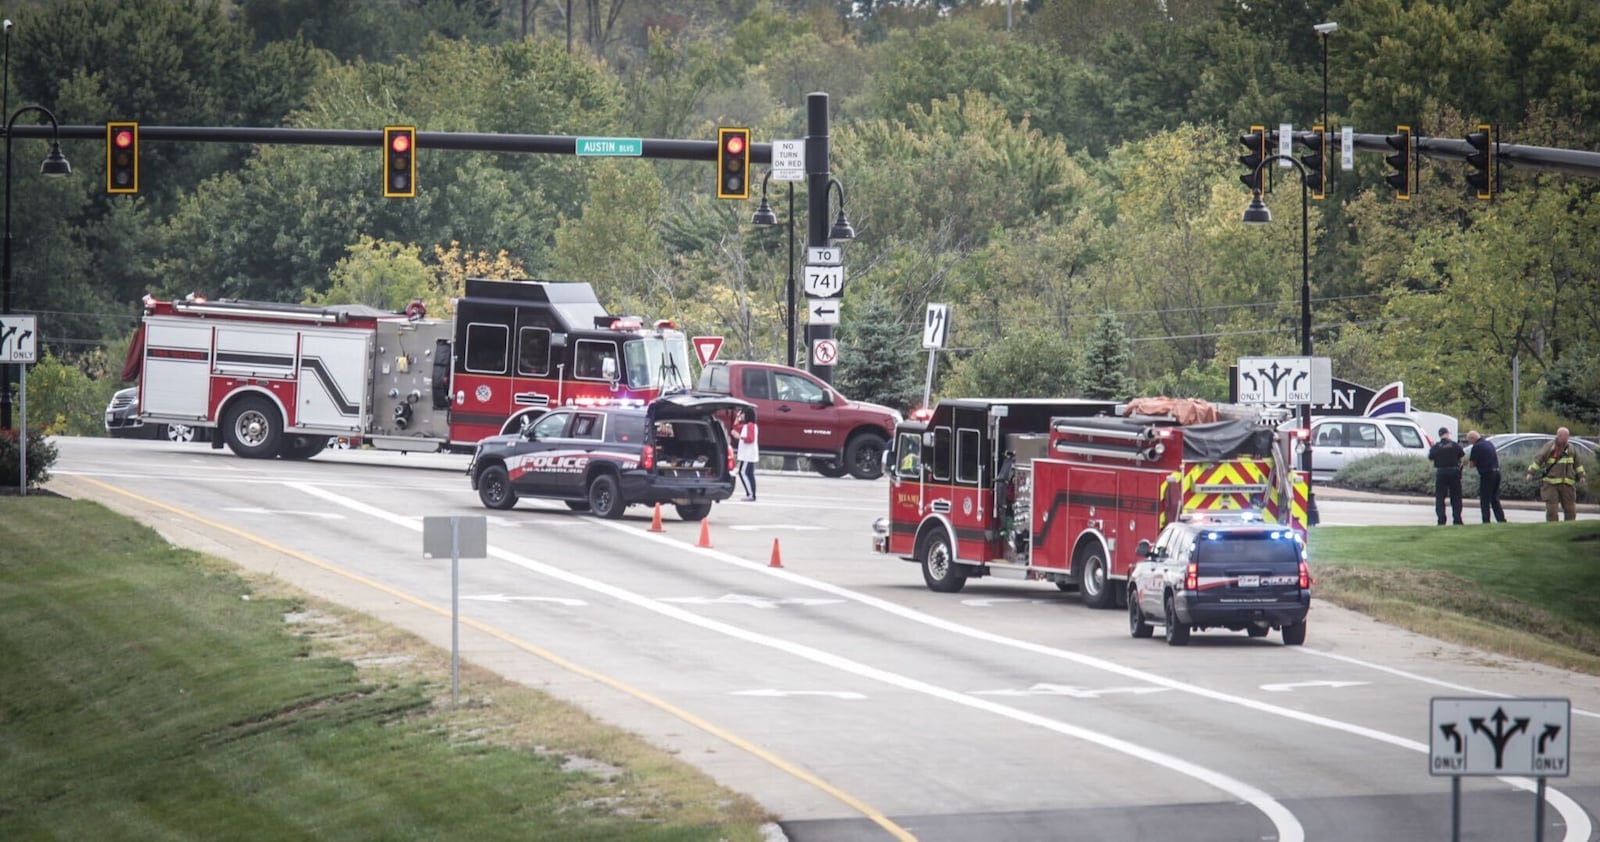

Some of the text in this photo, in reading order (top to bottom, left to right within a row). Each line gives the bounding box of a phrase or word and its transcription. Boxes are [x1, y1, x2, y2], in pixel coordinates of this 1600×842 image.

[583, 141, 634, 152] AUSTIN BLVD
[817, 251, 832, 261] TO
[810, 274, 837, 289] 741
[13, 351, 33, 359] ONLY
[1240, 392, 1261, 401] ONLY
[1288, 391, 1310, 400] ONLY
[521, 456, 589, 469] POLICE
[1434, 757, 1463, 770] ONLY
[1535, 757, 1564, 770] ONLY
